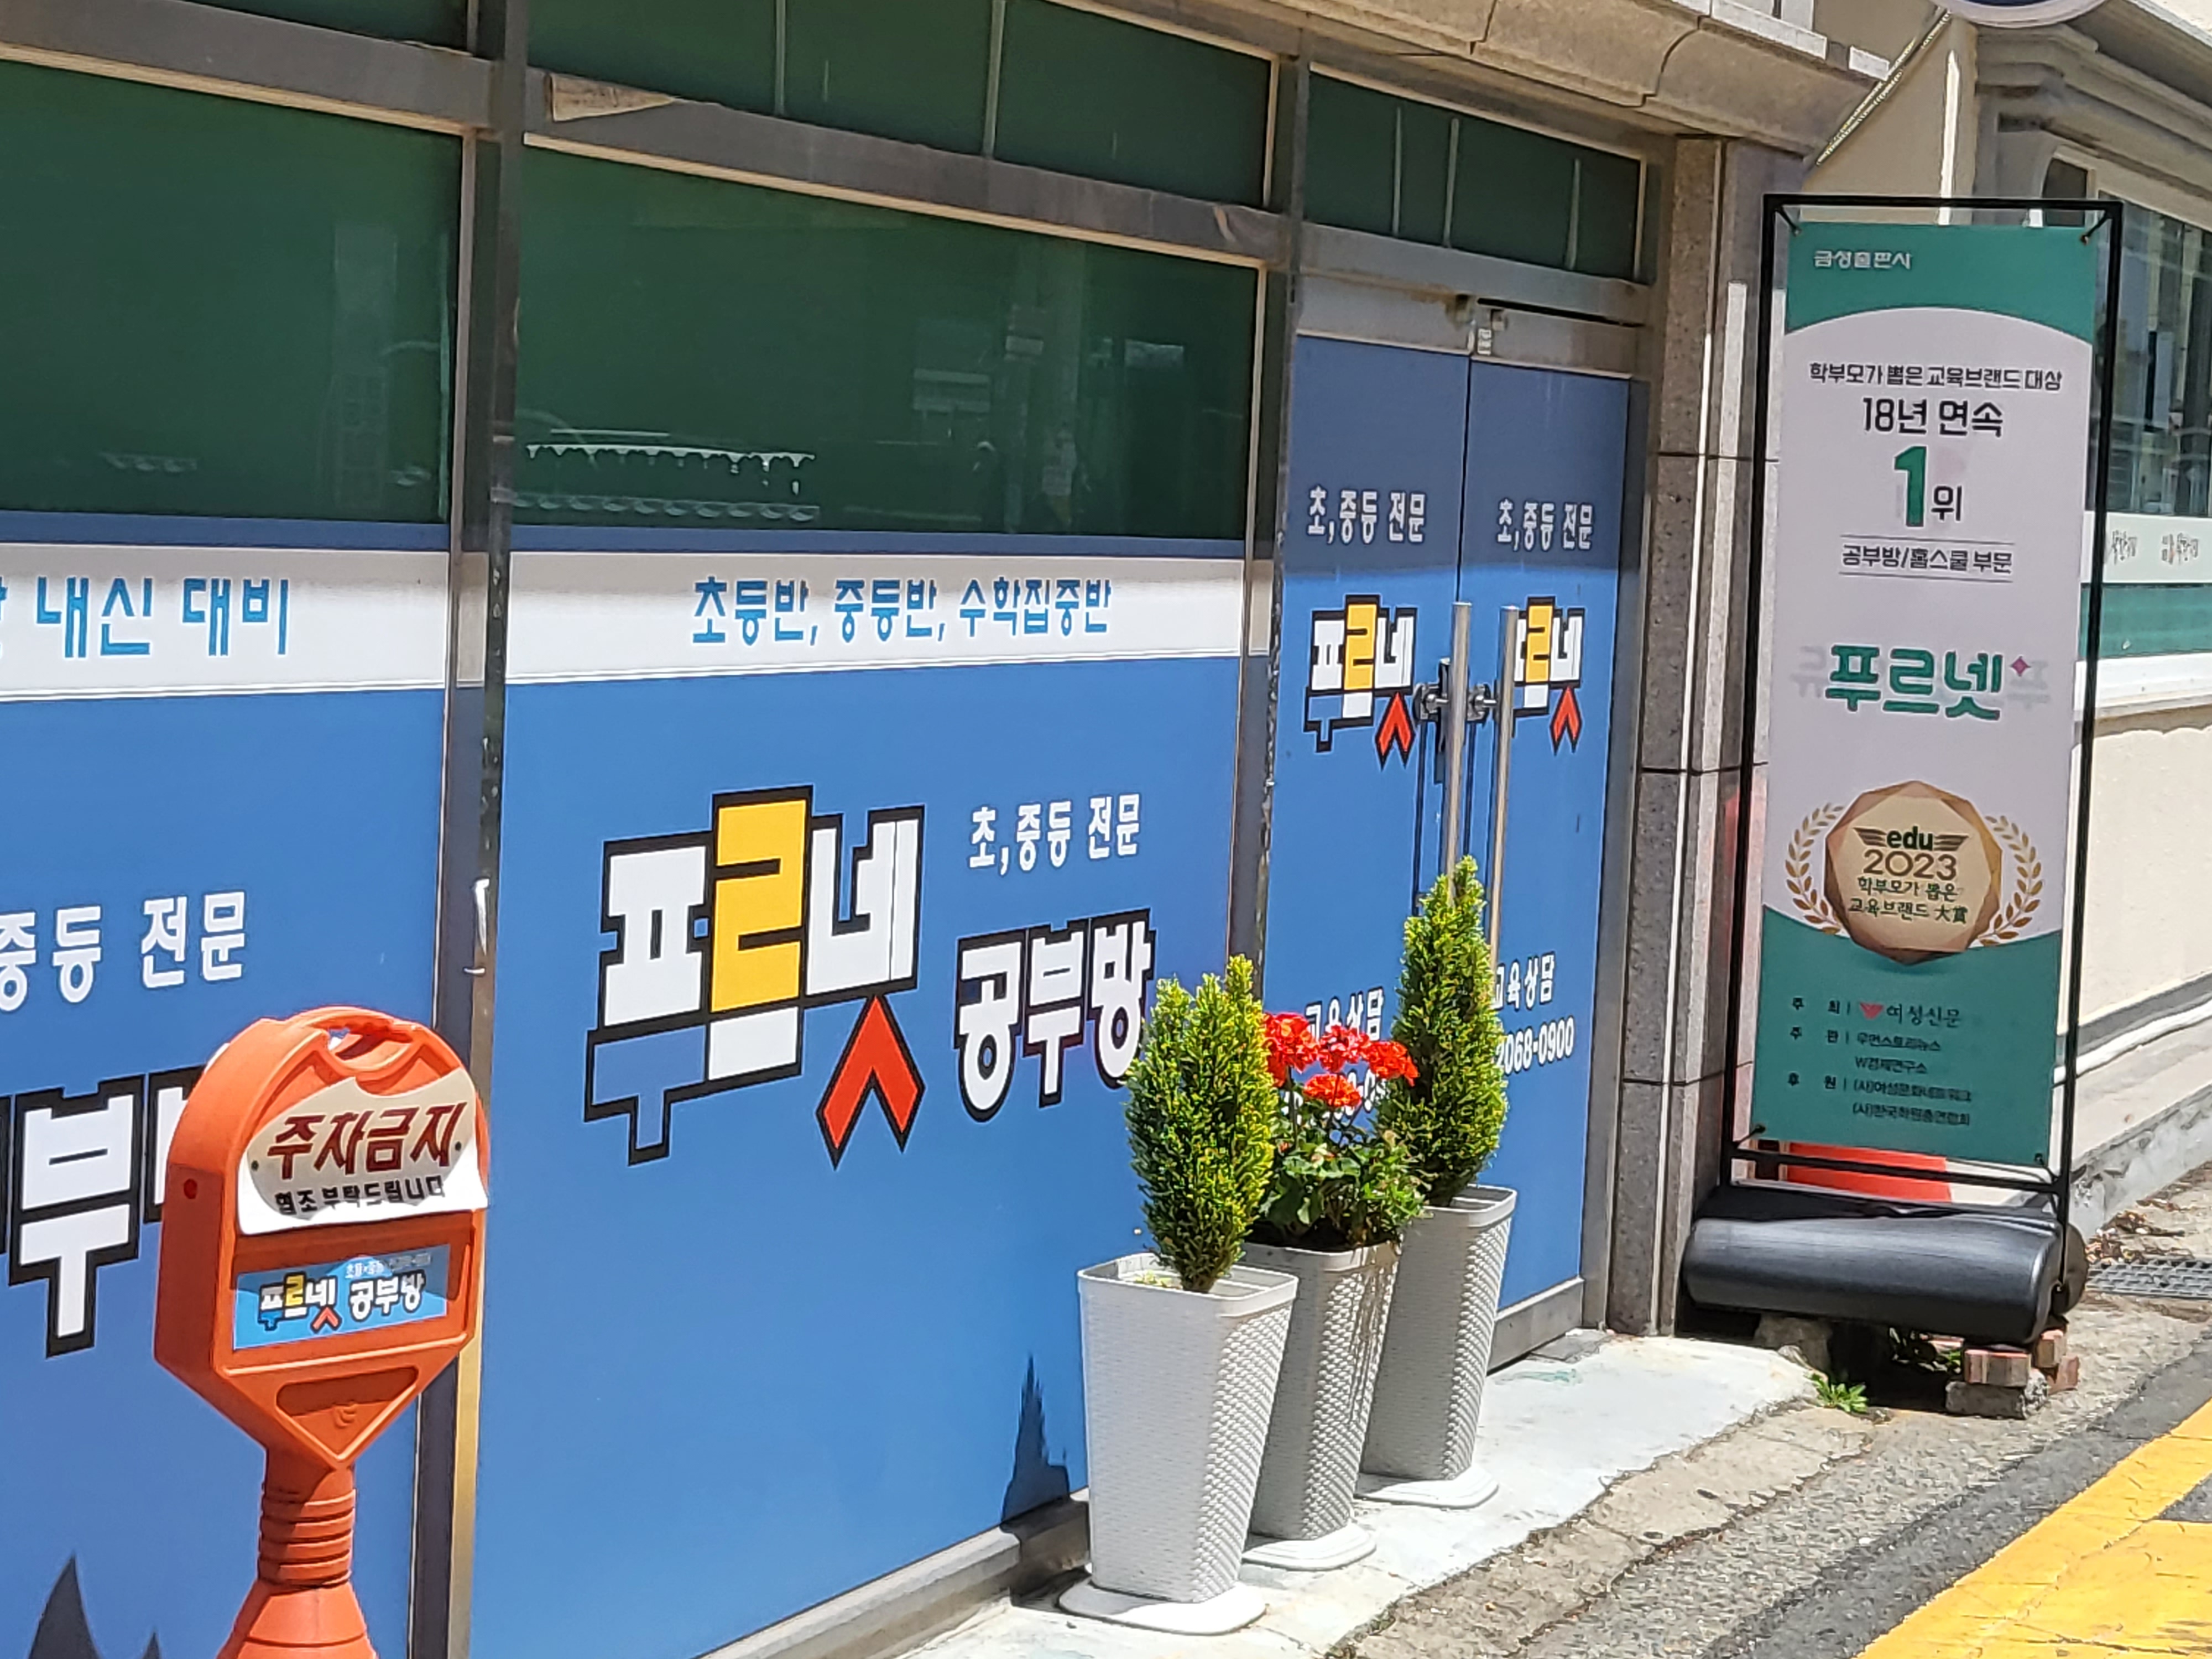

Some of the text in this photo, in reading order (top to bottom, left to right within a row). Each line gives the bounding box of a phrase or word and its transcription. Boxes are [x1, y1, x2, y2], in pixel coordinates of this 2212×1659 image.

[1814, 251, 1912, 269] 금성출판사
[1810, 363, 2062, 391] 학부모가 뽑은 교육브랜드 대상
[1863, 398, 2002, 437] 18년 연속
[1307, 487, 1426, 544] 초,중등 전문
[1498, 499, 1593, 550] 초,중등 전문
[1843, 545, 2011, 573] 공부방/홈스쿨 부문
[36, 577, 152, 658] 내신
[182, 578, 288, 656] 대비
[693, 576, 1111, 645] 초등반, 중등반, 수학집중반
[1303, 594, 1417, 770] 푸르넷
[1825, 645, 2003, 721] 푸르넷
[969, 793, 1140, 875] 초,중등 전문
[1886, 826, 1933, 851] edu
[1858, 877, 1919, 896] 학부모가
[1863, 849, 1957, 880] 2023
[1849, 898, 1930, 921] 교육브랜드
[141, 891, 246, 988] 전문
[583, 785, 925, 1170] 푸르넷
[954, 908, 1156, 1122] 공부방
[1886, 1003, 1961, 1027] 여성신문
[268, 1102, 467, 1180] 주차금지
[275, 1175, 445, 1215] 협조 부탁드립니다
[258, 1269, 426, 1333] 푸르넷 공부방
